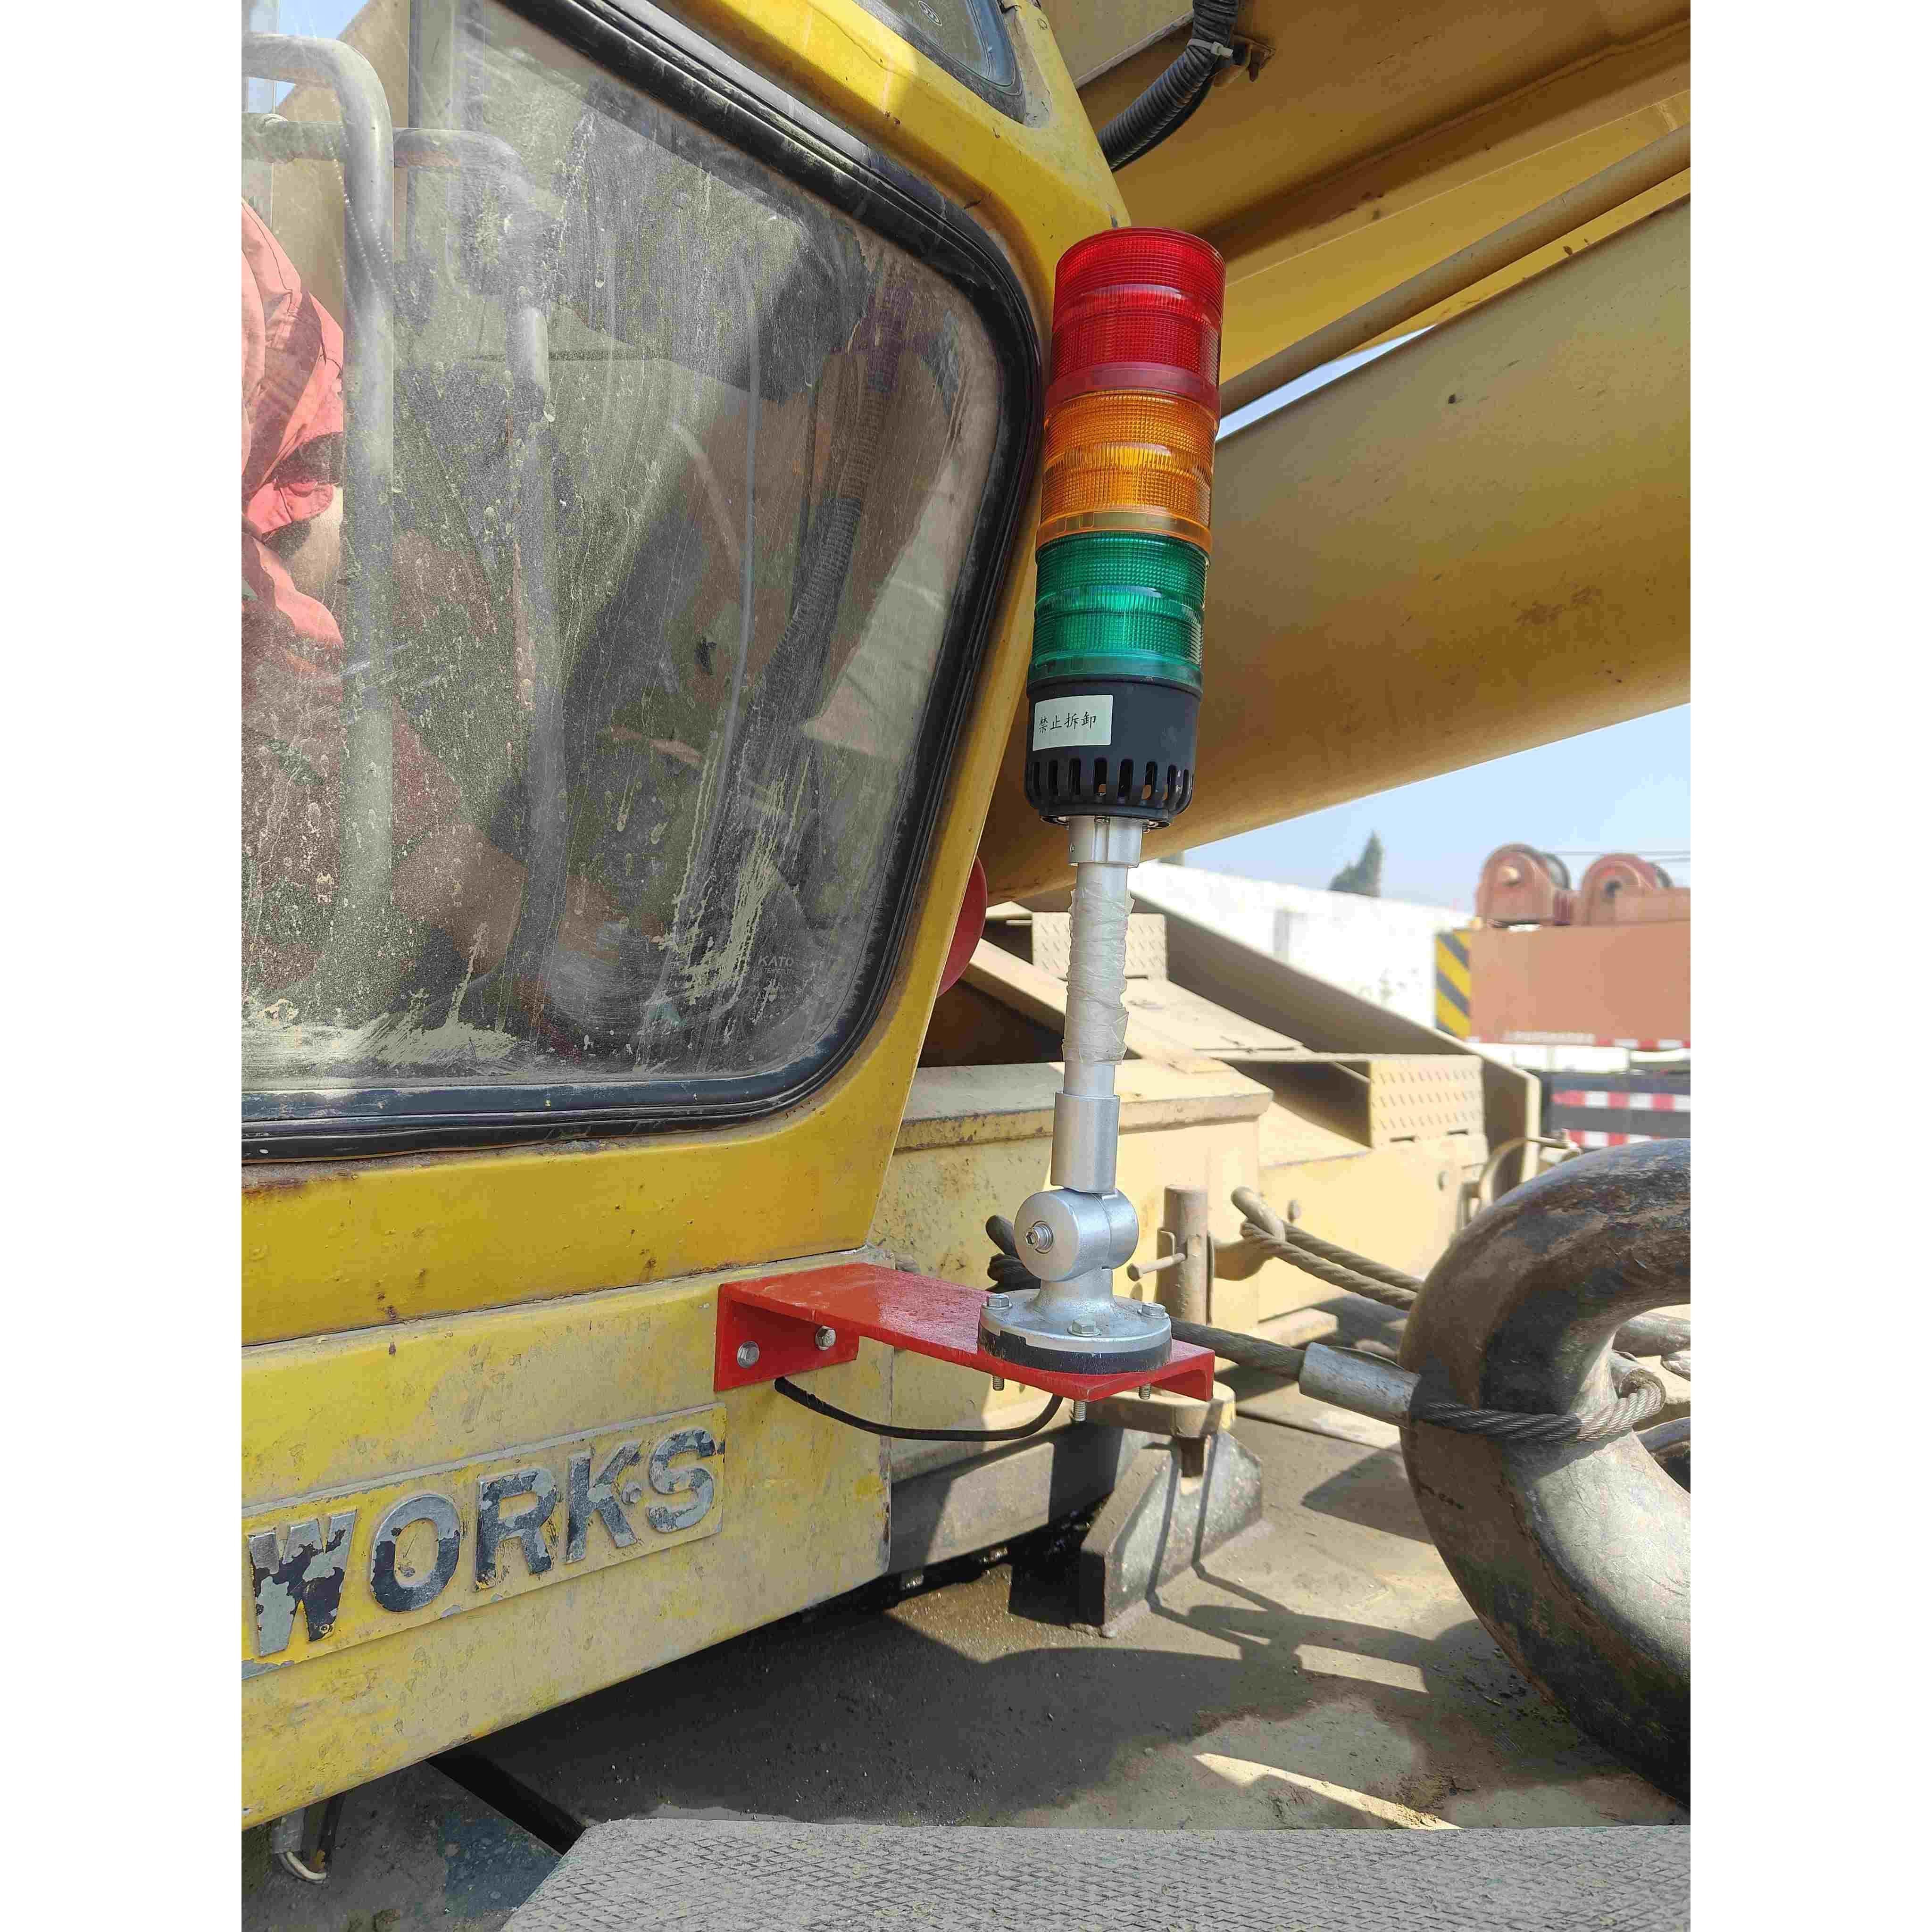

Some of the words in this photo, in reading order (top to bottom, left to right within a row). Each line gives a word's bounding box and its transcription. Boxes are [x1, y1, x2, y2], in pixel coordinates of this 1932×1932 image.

[1038, 711, 1096, 733] 禁止拆卸
[758, 955, 794, 966] KATO
[248, 1429, 722, 1657] WORKS
